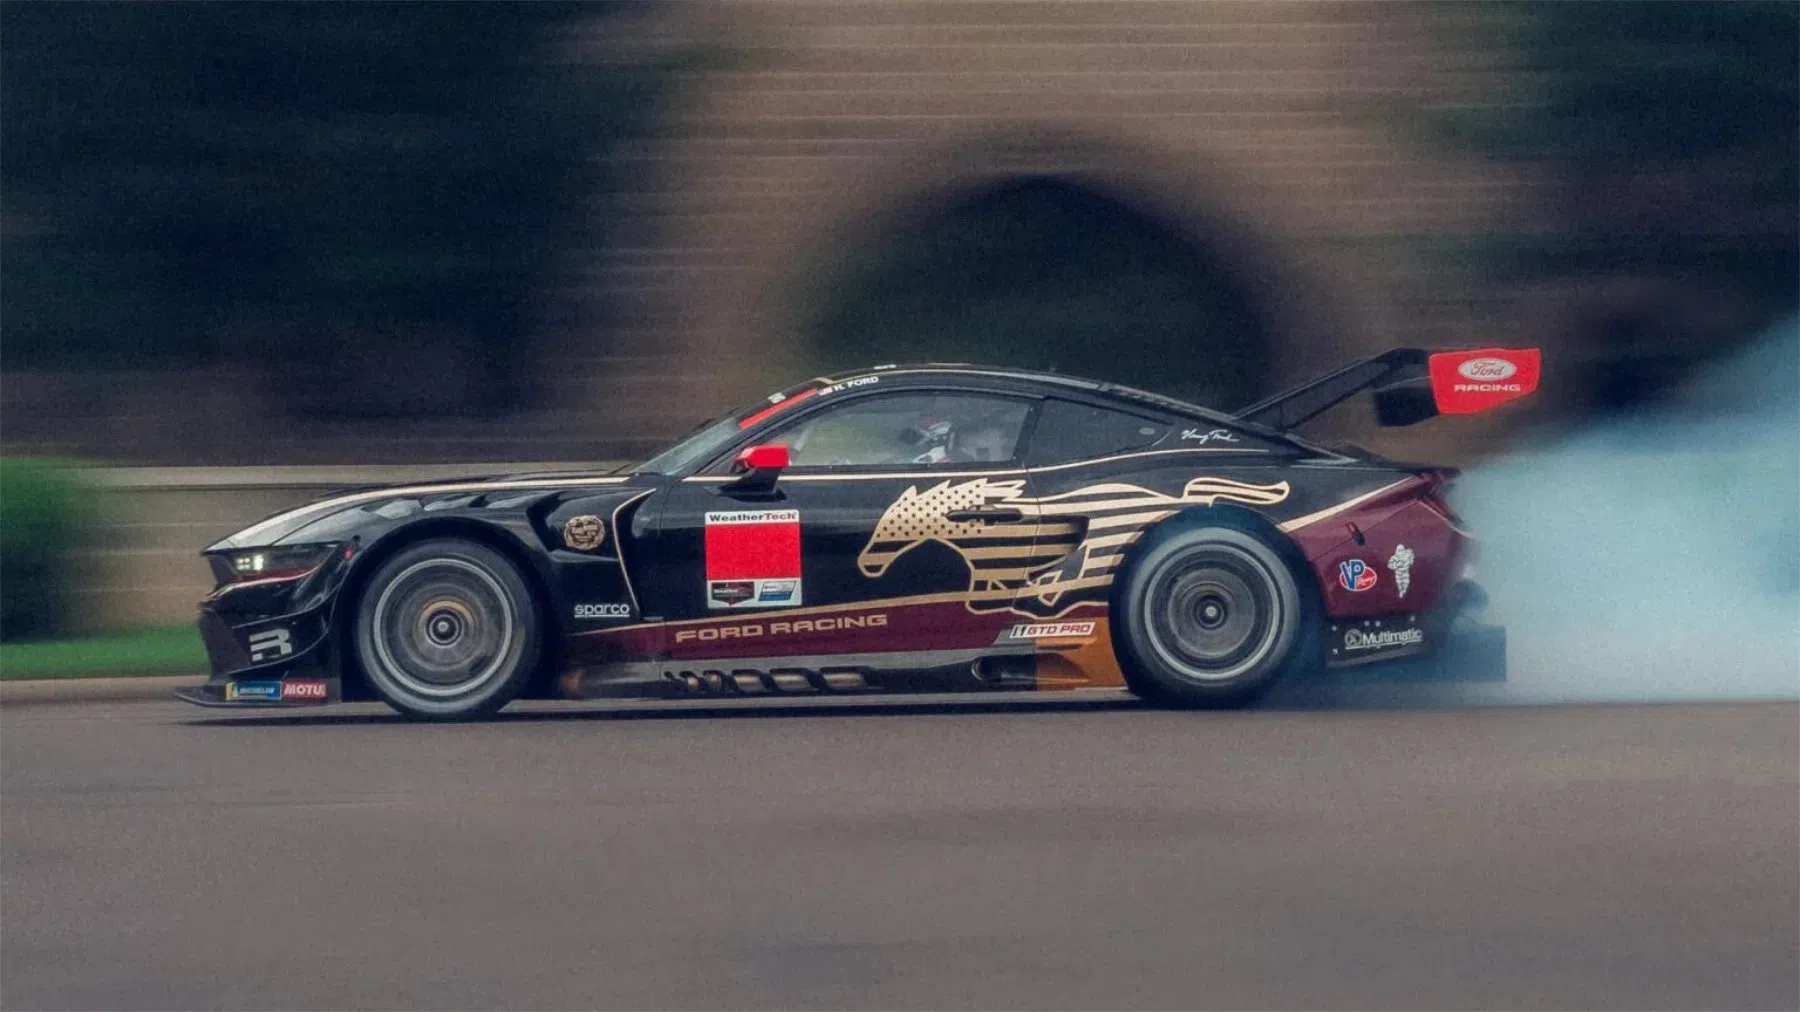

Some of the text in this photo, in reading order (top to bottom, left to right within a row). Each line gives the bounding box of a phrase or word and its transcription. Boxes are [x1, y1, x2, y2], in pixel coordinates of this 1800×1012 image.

[1471, 361, 1505, 376] Ford
[847, 376, 879, 388] FORD
[1453, 383, 1521, 392] RACING
[709, 512, 796, 522] WeatherTech
[574, 604, 630, 618] sparco
[675, 614, 888, 643] FORD RACING
[1027, 624, 1091, 635] GTD PRO
[1362, 628, 1423, 645] Multimatic
[284, 684, 326, 696] MOTUL
